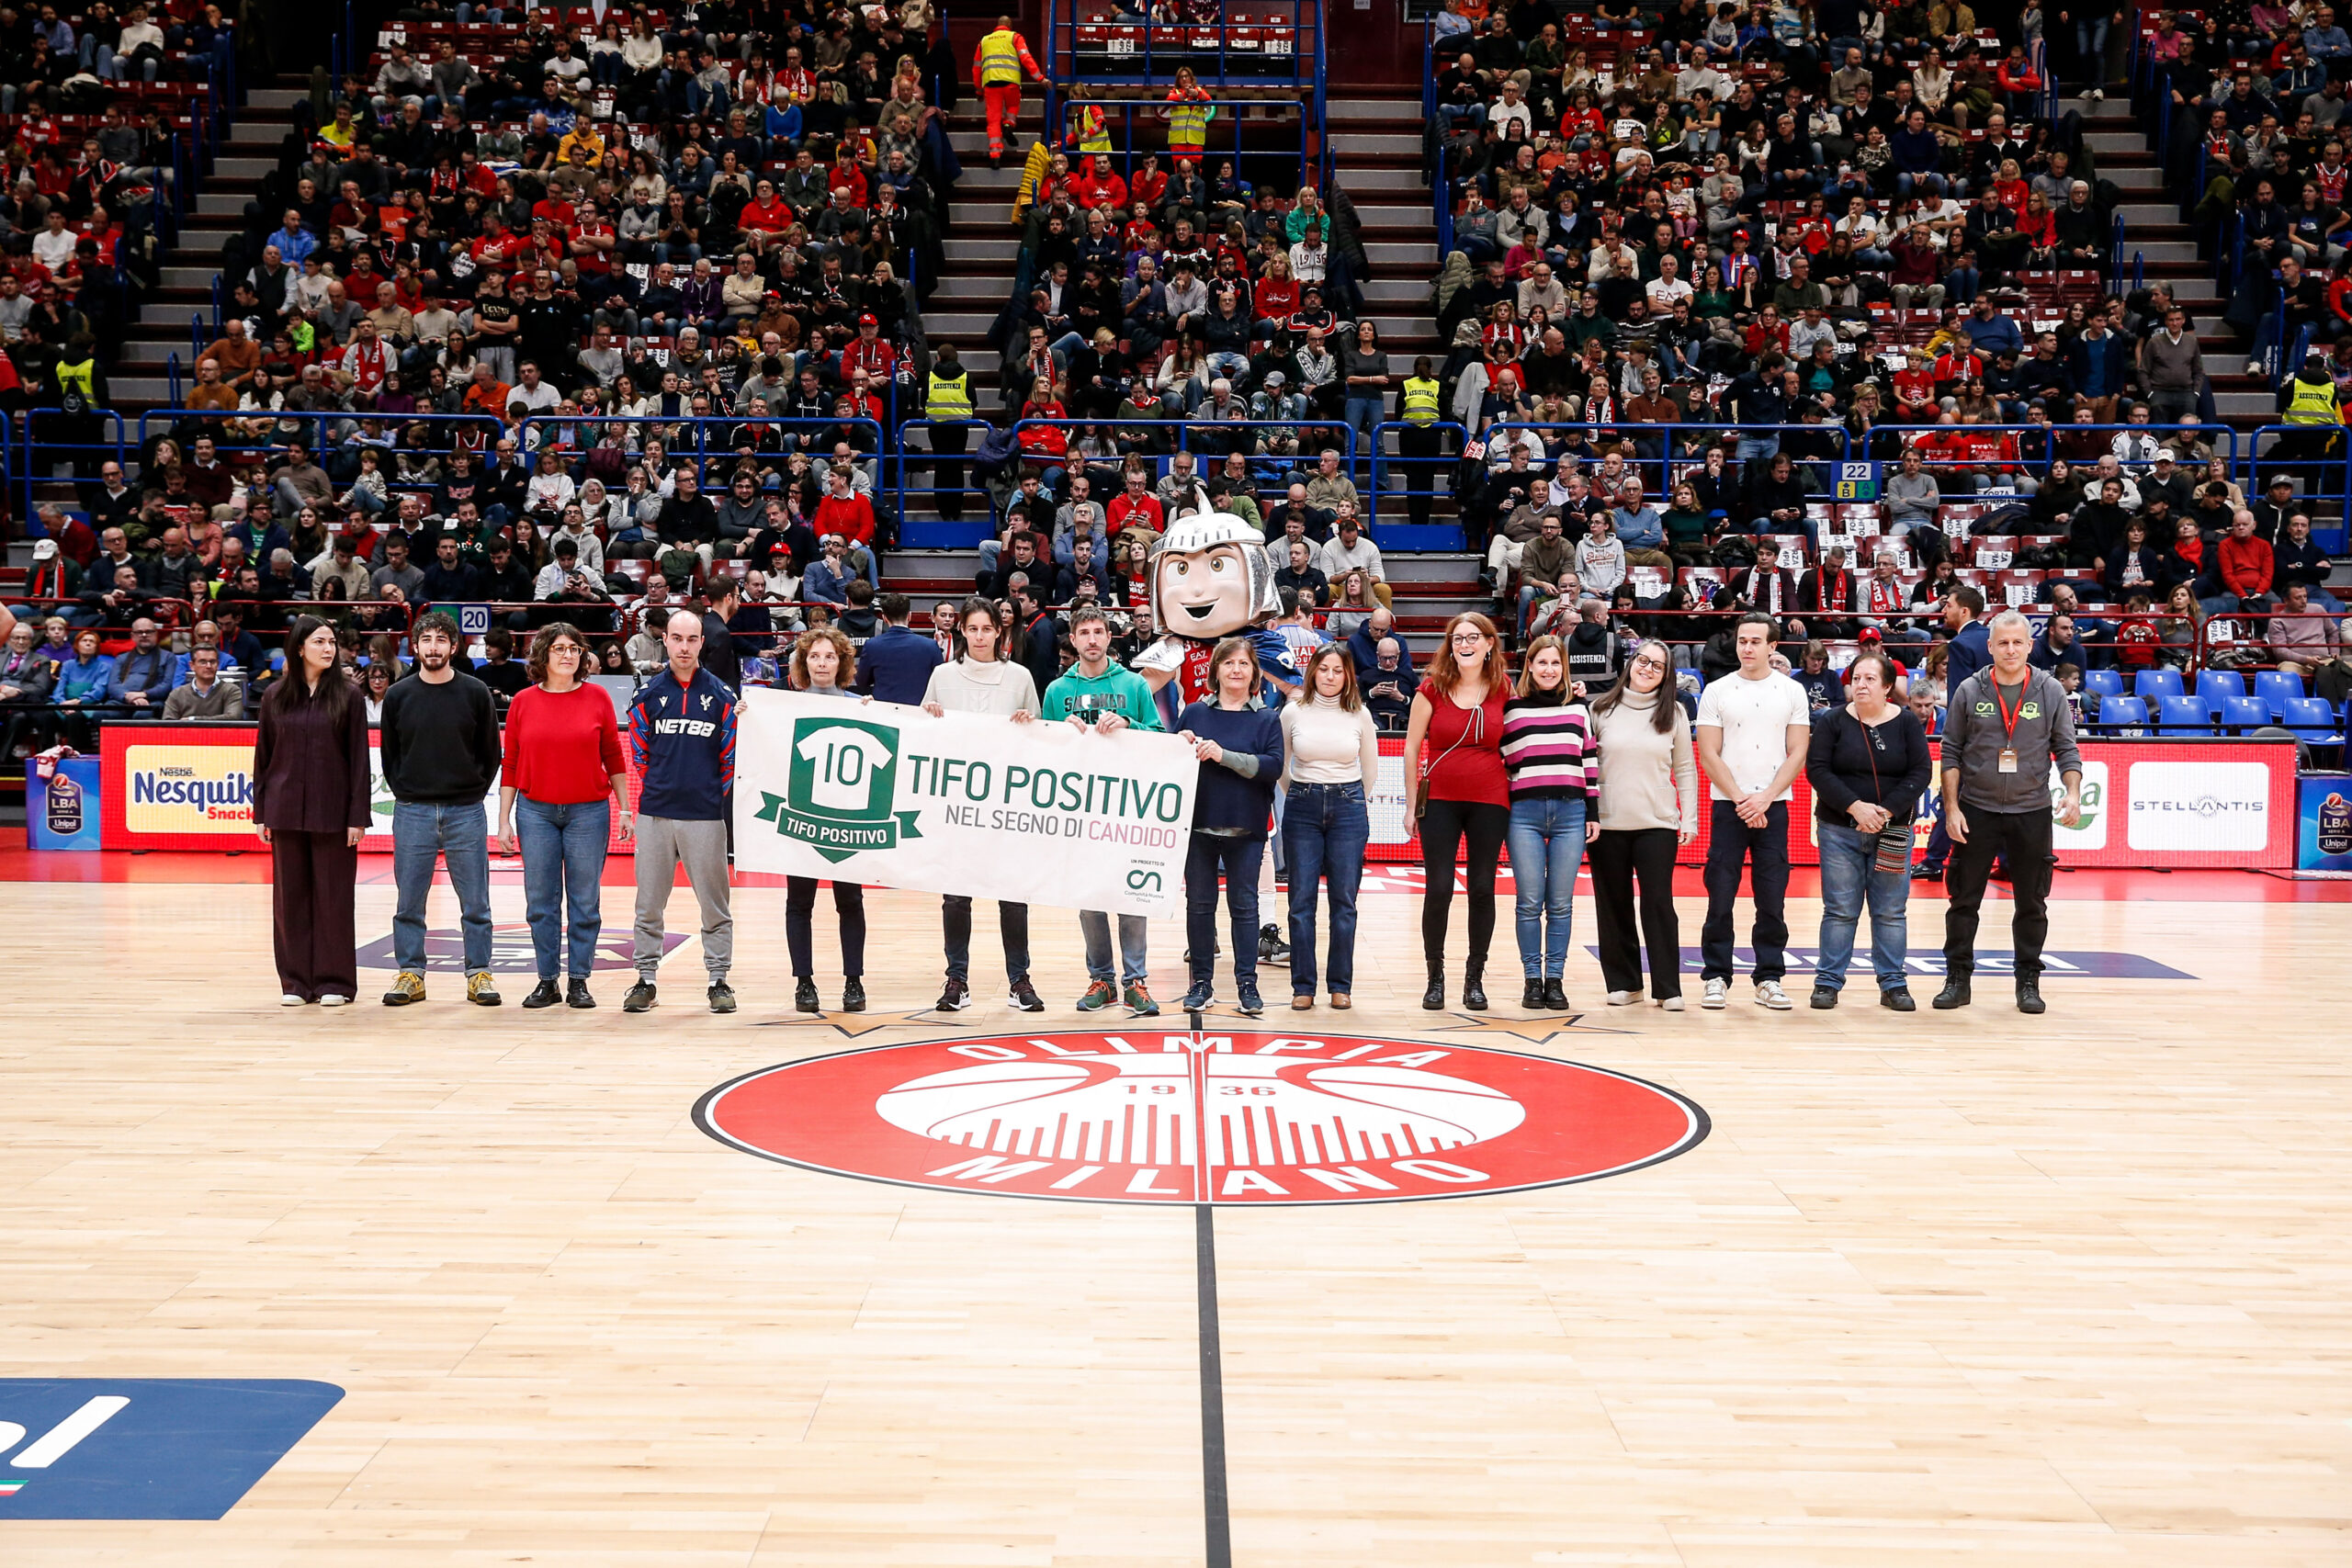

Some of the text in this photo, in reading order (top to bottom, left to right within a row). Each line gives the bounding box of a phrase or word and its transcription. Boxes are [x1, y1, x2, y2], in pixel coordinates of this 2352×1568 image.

[1408, 389, 1434, 398] ASSISTENZA
[2299, 392, 2328, 400] ASSISTENZA
[1846, 465, 1867, 478] 22
[1842, 489, 1850, 497] B
[464, 611, 486, 628] 20
[1568, 654, 1606, 664] ASSISTENZA
[655, 718, 717, 738] NET88
[824, 742, 864, 786] 10
[134, 772, 254, 812] Nesquik
[907, 754, 1182, 822] TIFO POSITIVO
[51, 798, 78, 808] LBA
[207, 807, 254, 820] Snack
[54, 818, 77, 828] Unipol
[945, 804, 1177, 849] NEL SEGNO DI CANDIDO
[2323, 818, 2350, 829] LBA
[786, 817, 888, 844] TIFO POSITIVO
[2324, 838, 2347, 849] Unipol
[947, 1036, 1452, 1068] OLIMPIA
[924, 1155, 1490, 1195] MILANO
